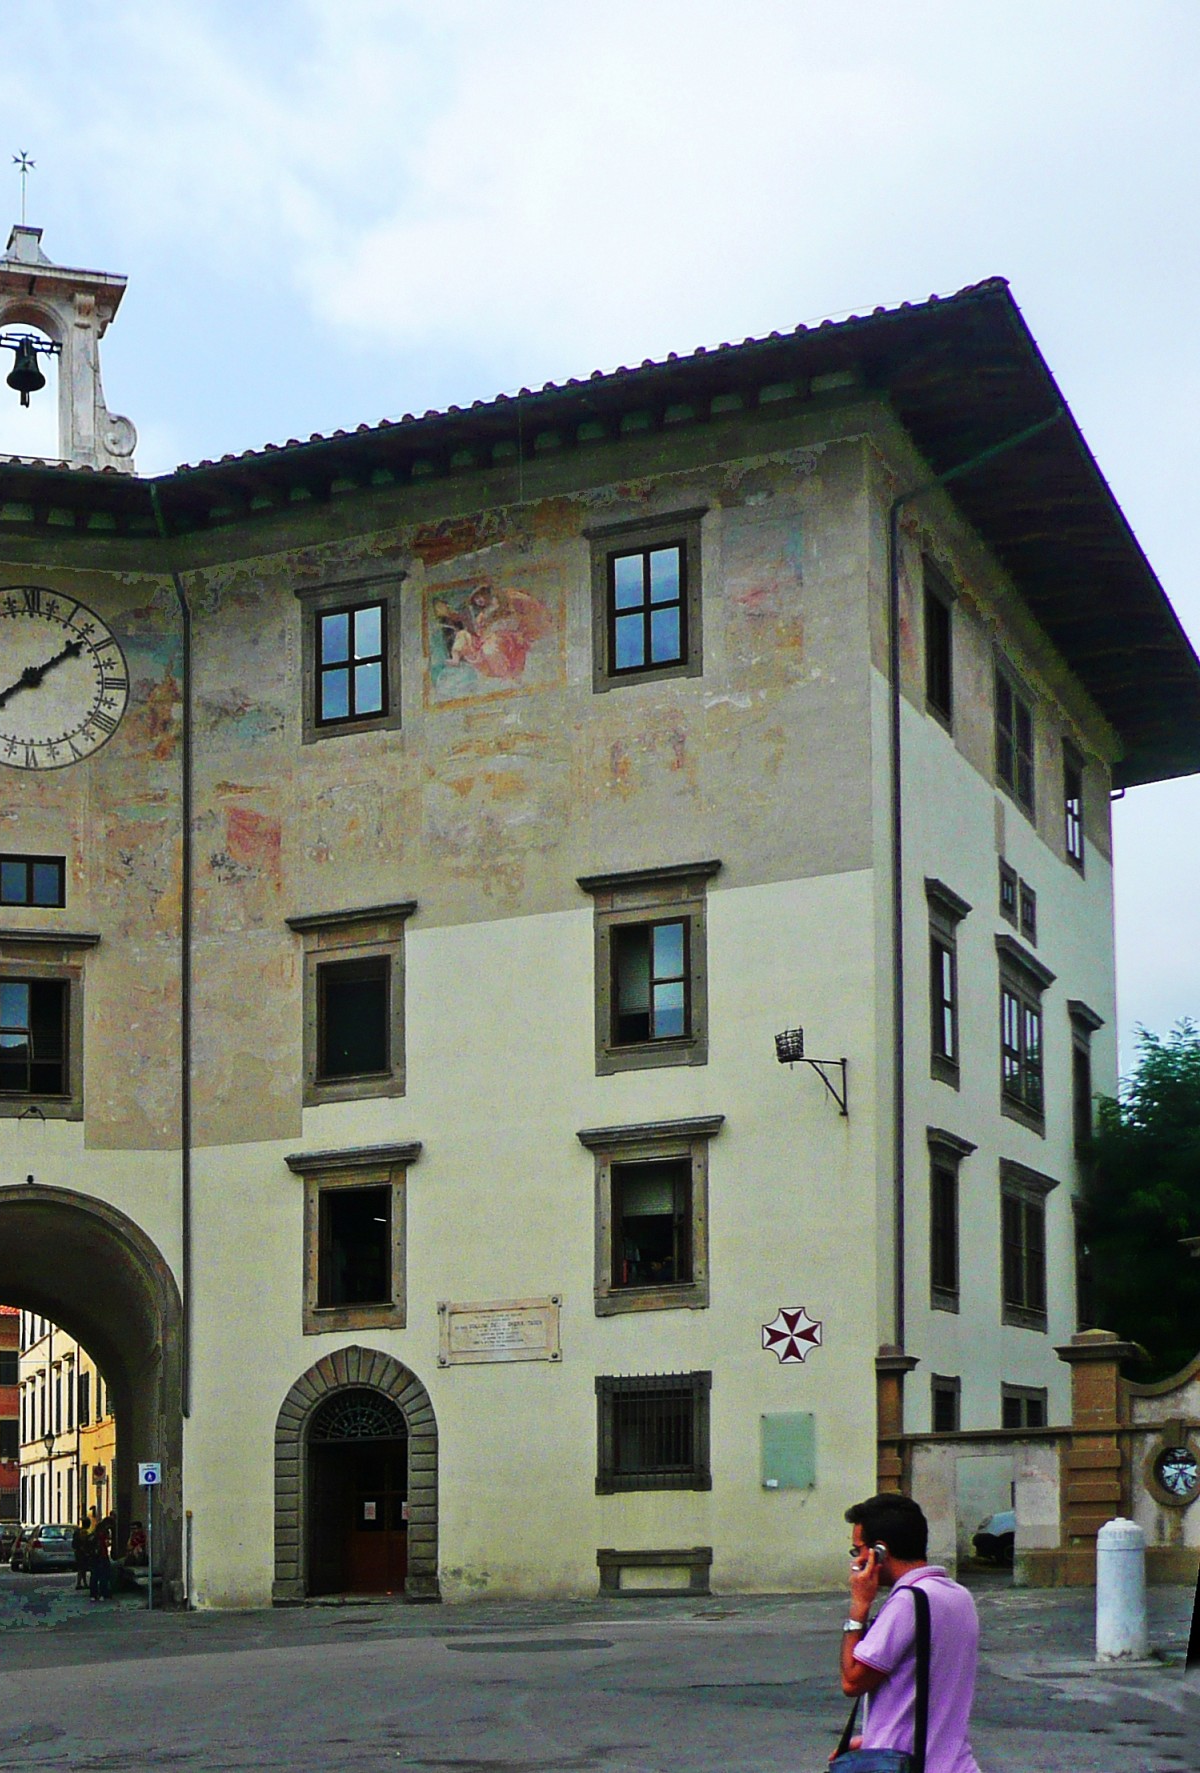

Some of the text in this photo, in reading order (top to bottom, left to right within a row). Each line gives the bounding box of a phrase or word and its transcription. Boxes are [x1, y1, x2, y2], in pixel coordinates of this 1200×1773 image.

[23, 588, 40, 611] XII
[67, 602, 81, 623] I
[93, 636, 115, 651] II
[104, 677, 127, 690] III
[91, 709, 118, 734] IIII
[25, 746, 38, 768] VI
[68, 740, 83, 761] V
